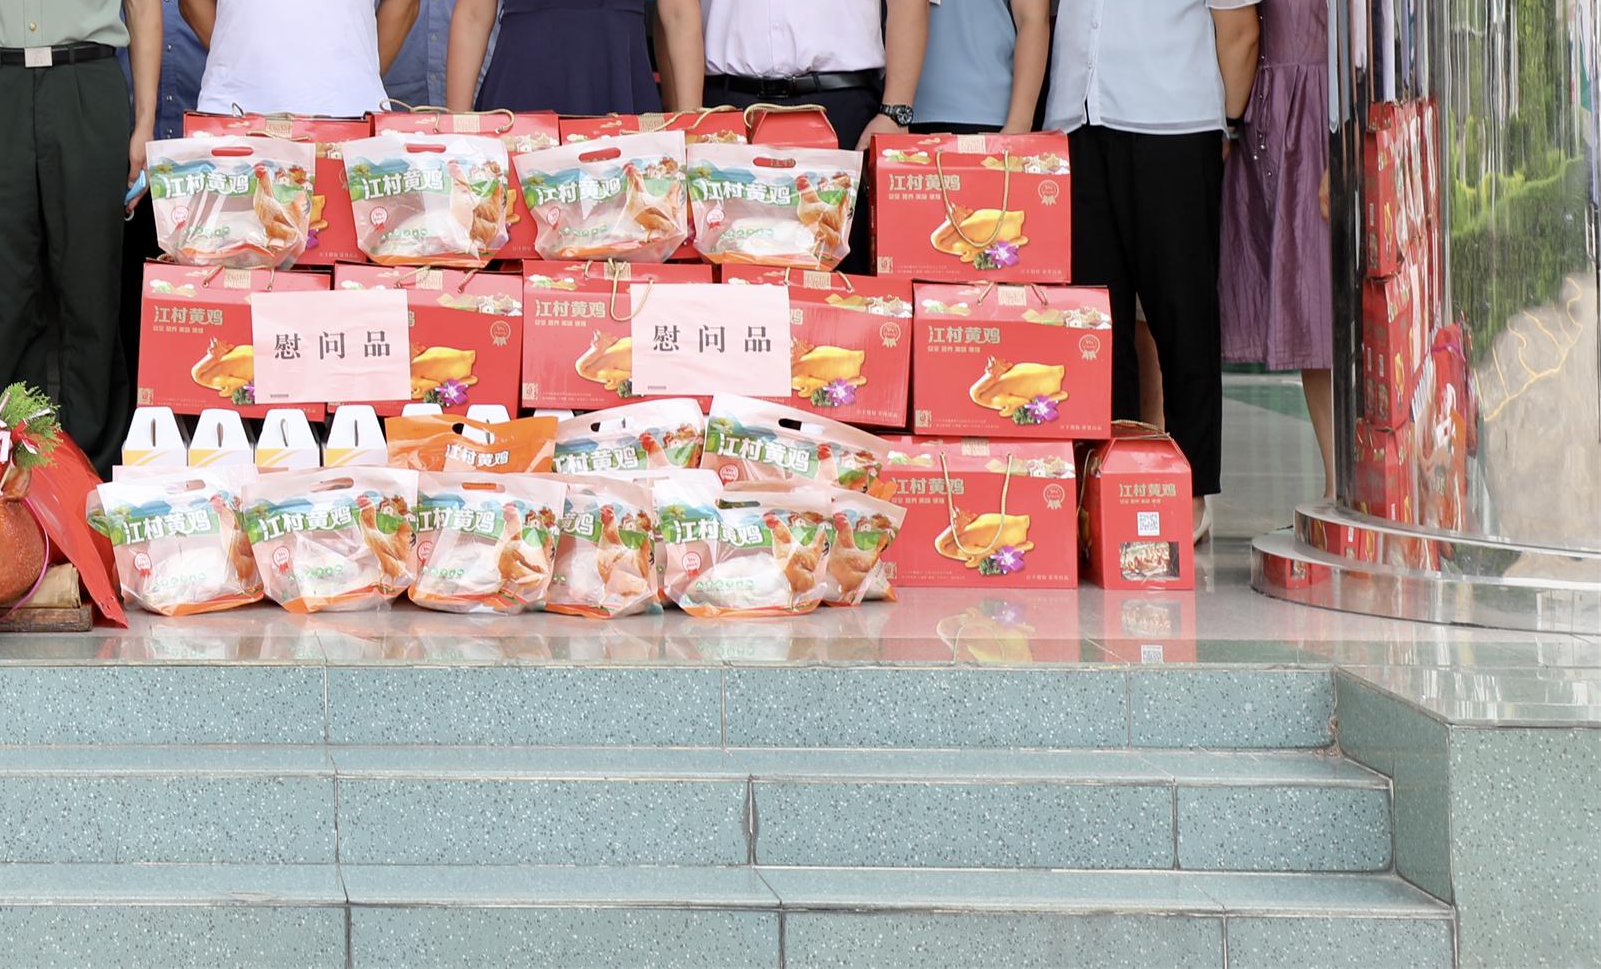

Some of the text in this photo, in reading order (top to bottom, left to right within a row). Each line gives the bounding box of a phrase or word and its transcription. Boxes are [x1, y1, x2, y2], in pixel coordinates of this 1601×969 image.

[164, 168, 250, 198] 江村黄鸡
[363, 167, 444, 200] 江村黄鸡
[536, 177, 622, 205] 江村黄鸡
[702, 181, 792, 204] 江村黄鸡
[887, 173, 961, 191] 江村黄鸡
[153, 304, 224, 326] 江村黄鸡
[534, 298, 606, 318] 江村黄鸡
[274, 329, 392, 361] 慰问品
[653, 324, 772, 353] 慰问品
[927, 325, 1000, 345] 江村黄鸡
[445, 443, 510, 468] 江村黄鸡
[718, 432, 811, 473] 江村黄鸡
[1118, 483, 1177, 498] 江村黄鸡
[124, 509, 212, 546] 江村黄鸡
[261, 505, 354, 542] 江村黄鸡
[674, 519, 765, 547] 江村黄鸡
